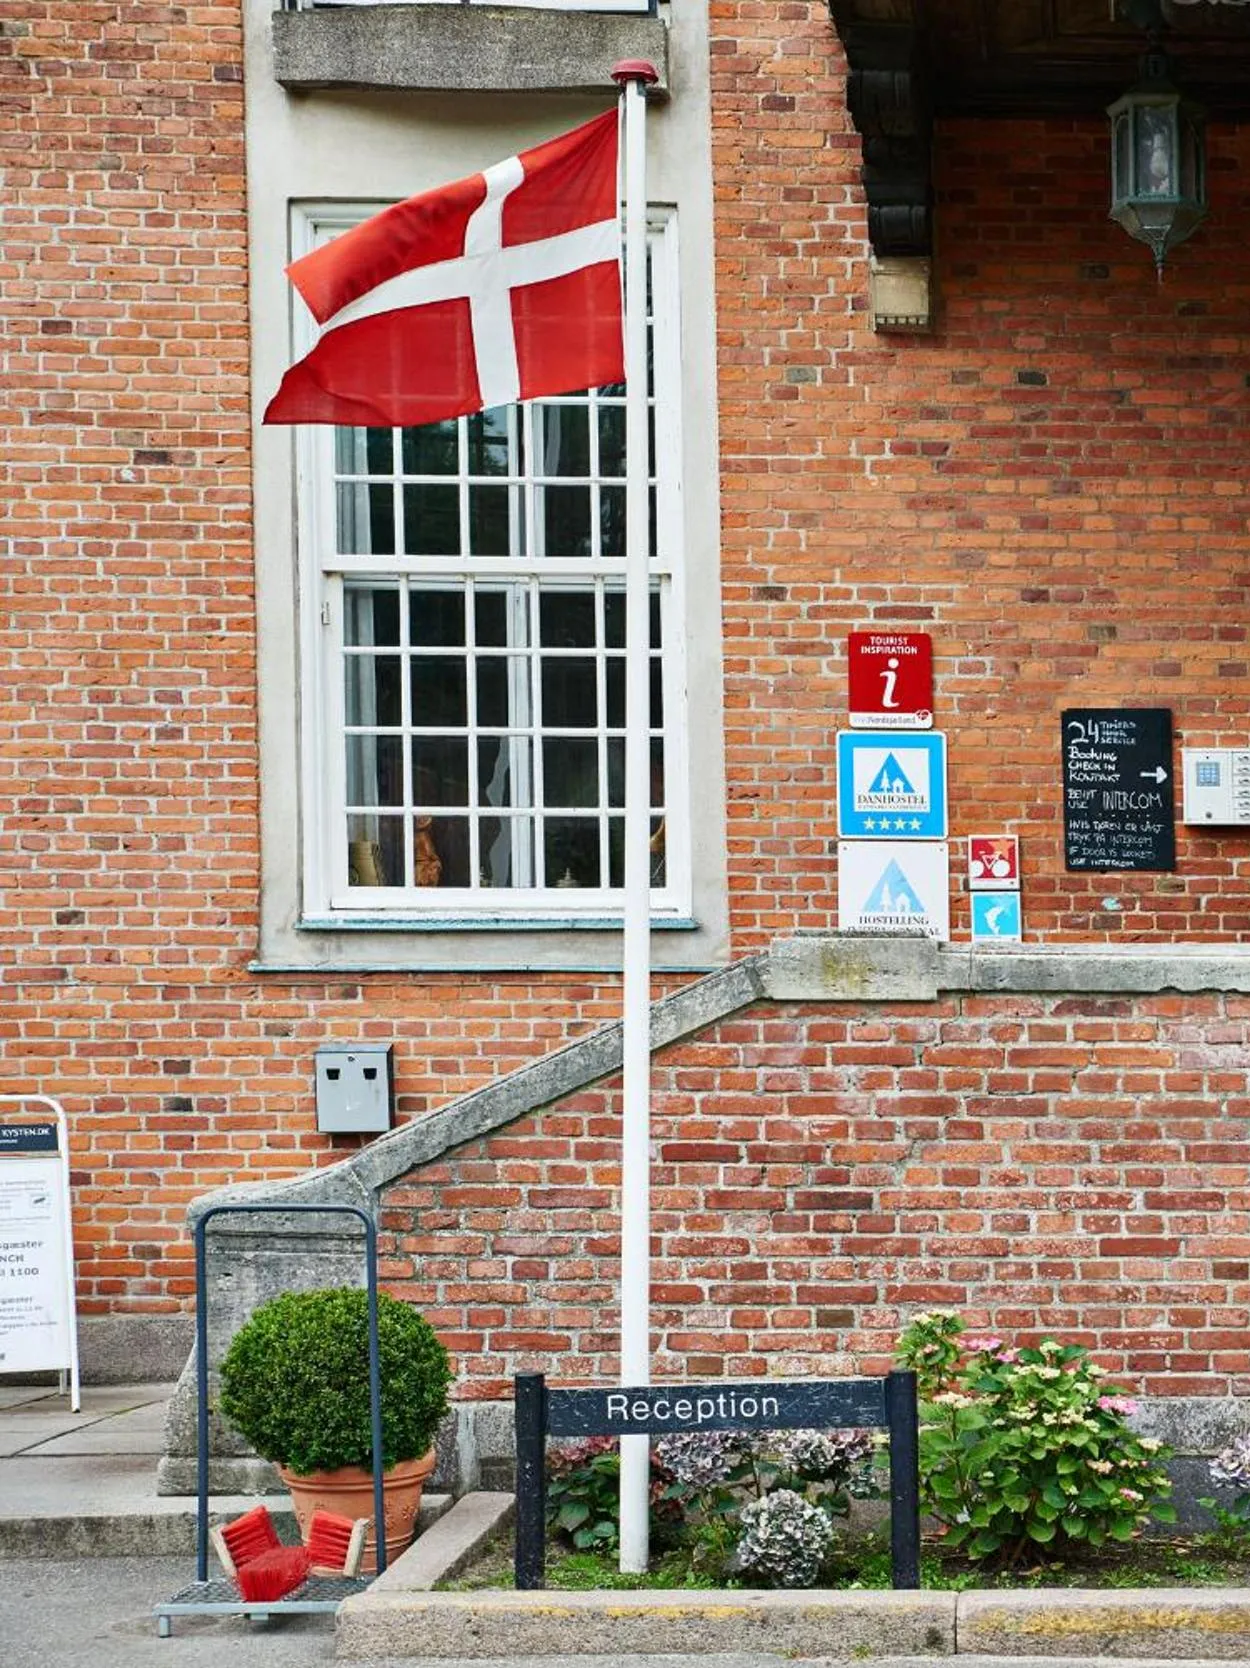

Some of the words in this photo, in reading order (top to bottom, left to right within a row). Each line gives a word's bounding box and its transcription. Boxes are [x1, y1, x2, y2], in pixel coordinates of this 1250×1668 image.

[869, 636, 909, 645] TOURIST
[861, 646, 918, 655] INSPIRATION
[1067, 718, 1099, 744] 24
[1069, 769, 1121, 783] KONTAKT
[857, 794, 927, 804] DANHOSTEL
[1102, 790, 1163, 811] INTERCOM
[1067, 801, 1089, 809] USE
[859, 915, 930, 925] HOSTELLING
[607, 1391, 779, 1423] Reception
